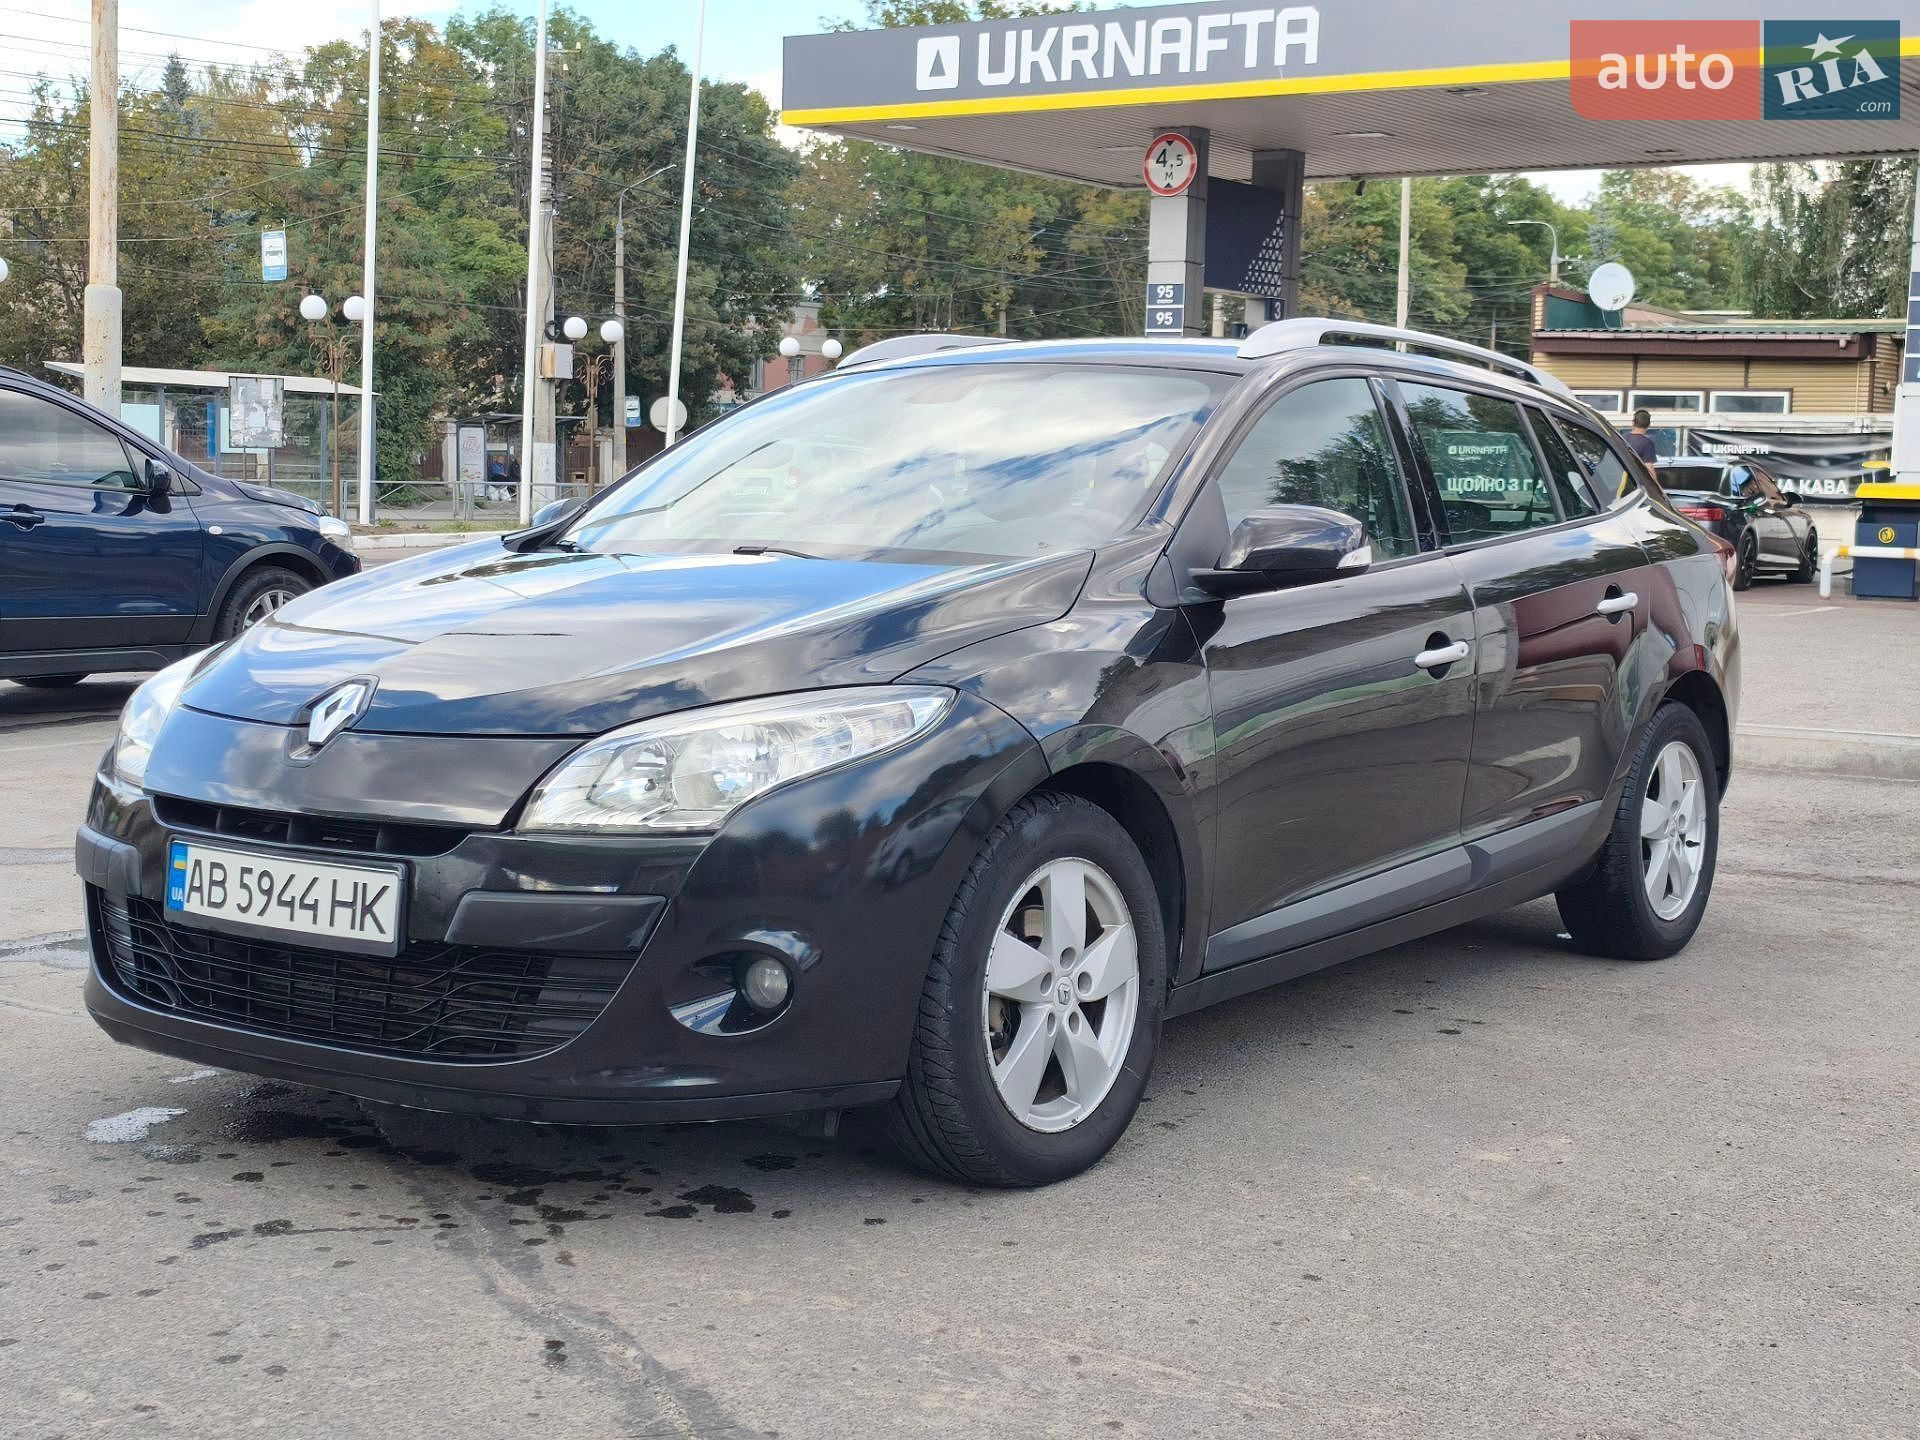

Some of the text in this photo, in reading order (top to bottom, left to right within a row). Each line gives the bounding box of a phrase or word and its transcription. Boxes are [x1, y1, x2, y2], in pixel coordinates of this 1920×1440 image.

[977, 6, 1320, 87] UKRNAFTA
[1156, 285, 1174, 299] 95
[1155, 311, 1174, 326] 95
[1274, 301, 1282, 320] 3
[1713, 443, 1769, 455] UKRNAFTA
[1799, 478, 1849, 496] КАВА
[171, 886, 184, 903] UA
[186, 858, 391, 936] AB 5944 HK
